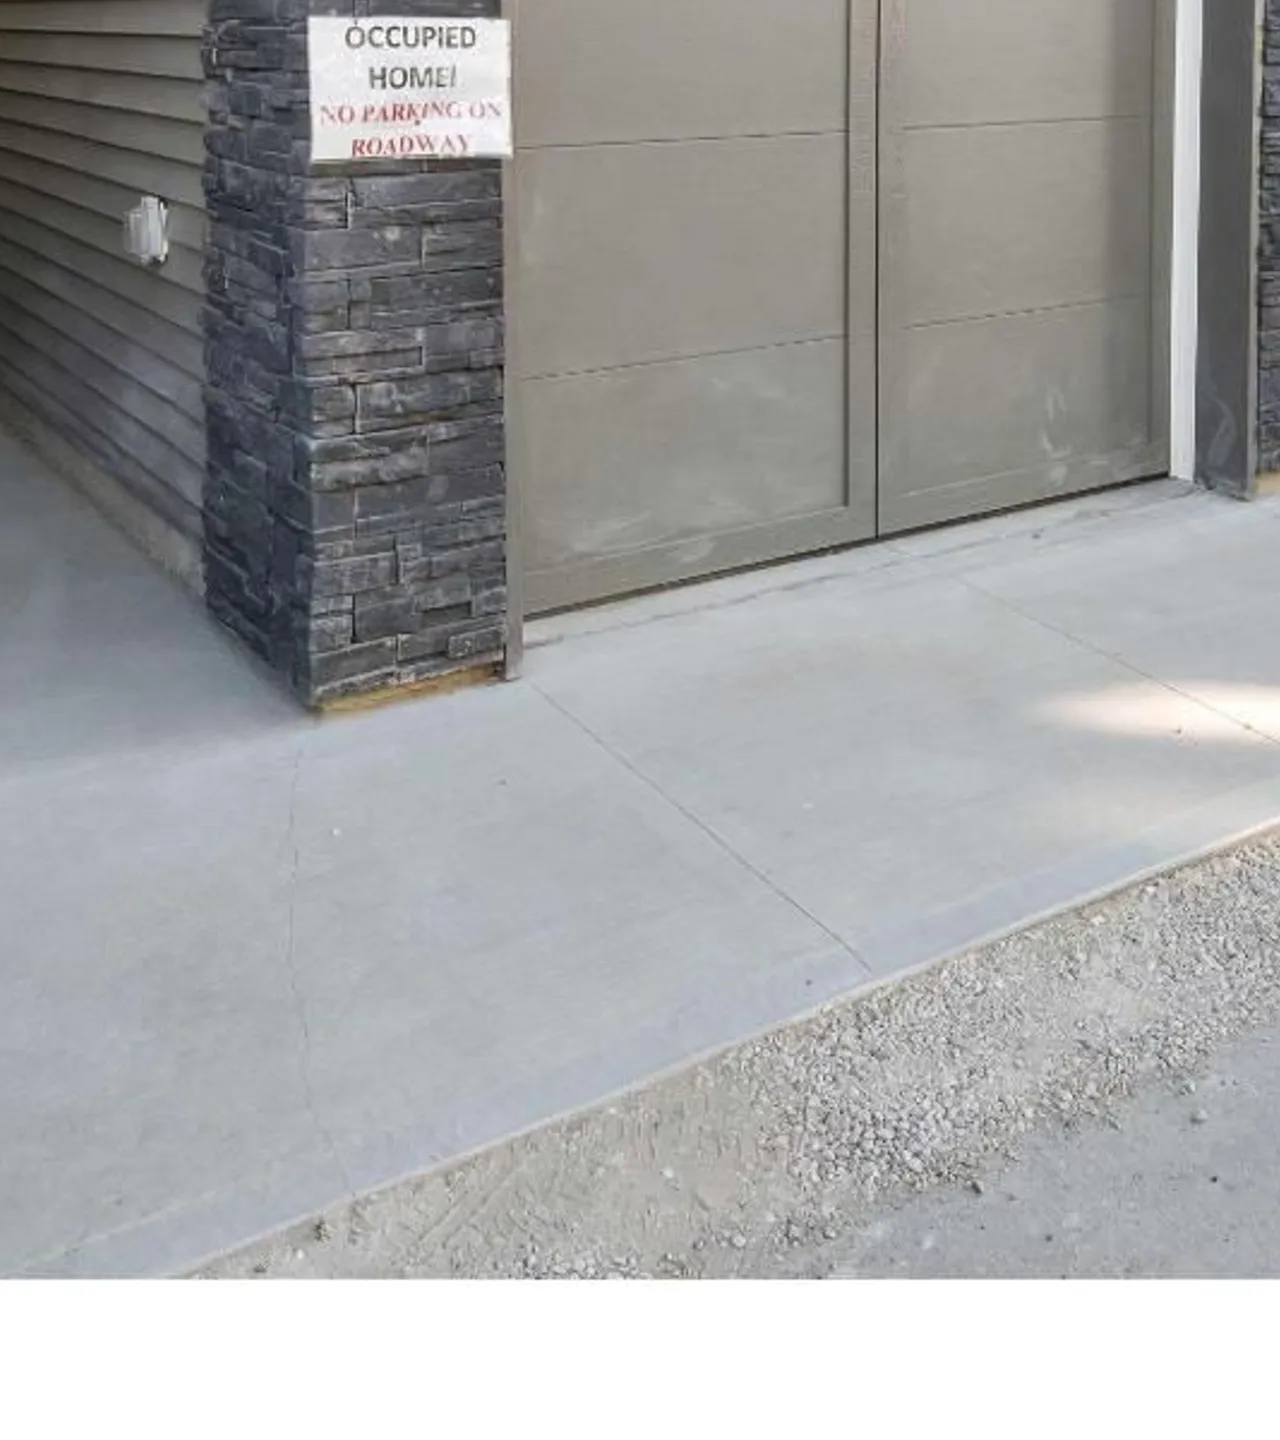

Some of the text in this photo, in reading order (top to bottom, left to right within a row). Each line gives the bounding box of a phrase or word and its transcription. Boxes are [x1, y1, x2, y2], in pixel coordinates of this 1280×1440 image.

[344, 25, 477, 49] OCCUPIED
[369, 64, 457, 90] HOME!
[321, 100, 503, 125] NO PARKING ON
[351, 134, 473, 157] ROADWAY
